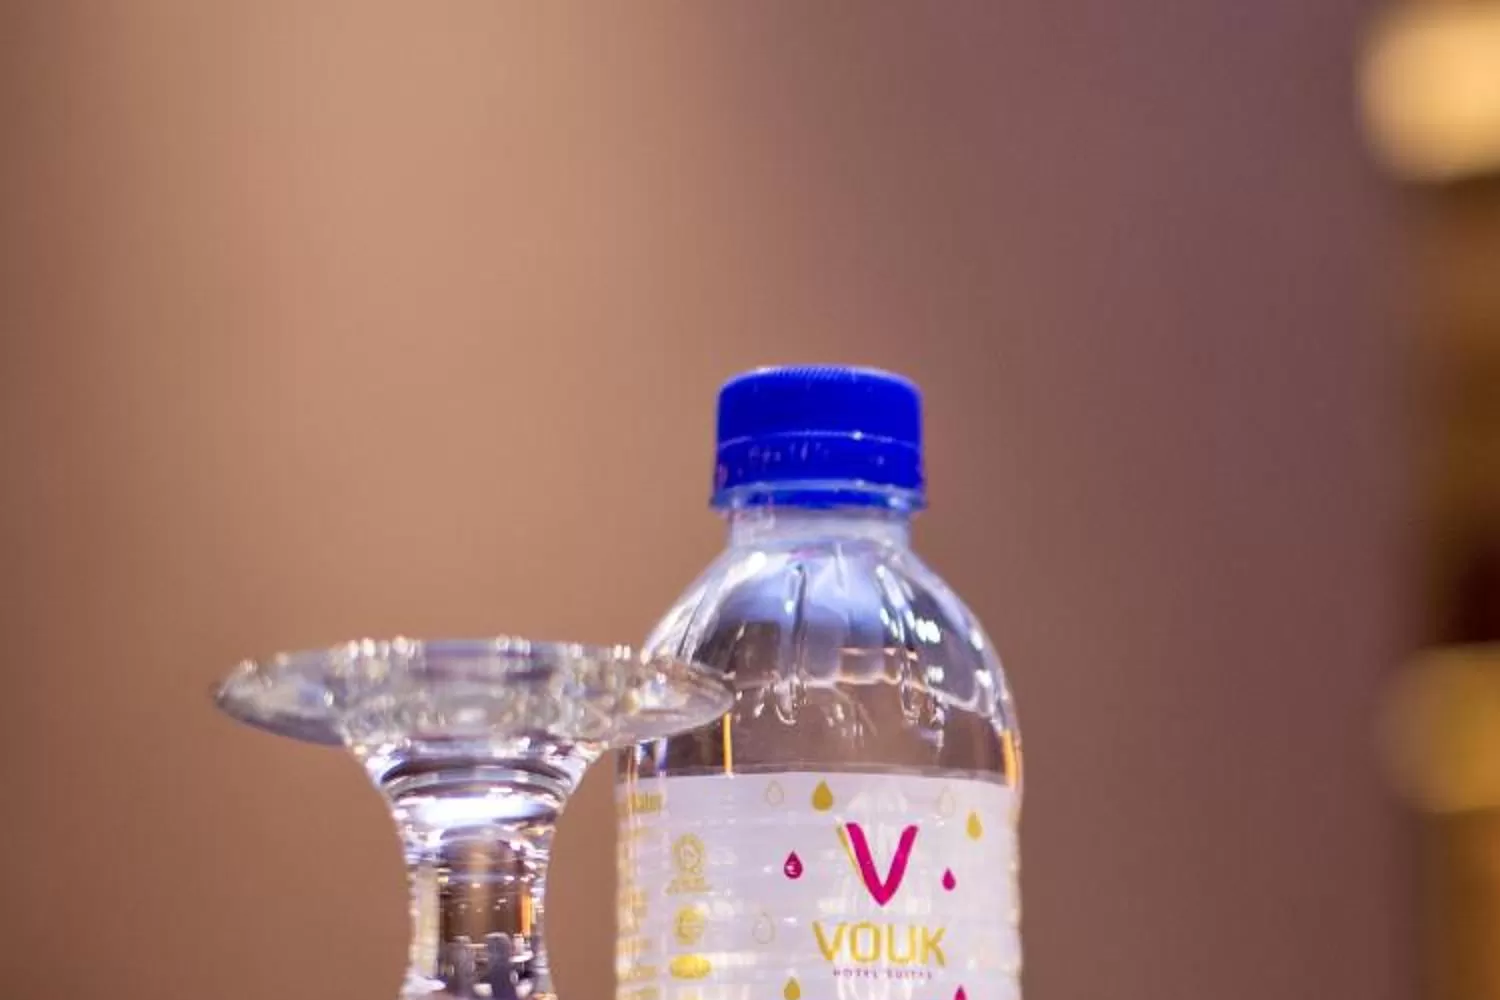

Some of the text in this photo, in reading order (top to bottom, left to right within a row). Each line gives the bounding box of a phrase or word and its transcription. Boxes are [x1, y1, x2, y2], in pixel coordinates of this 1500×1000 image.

[838, 821, 918, 906] V
[812, 920, 945, 967] VOUK
[832, 967, 878, 978] HOTEL
